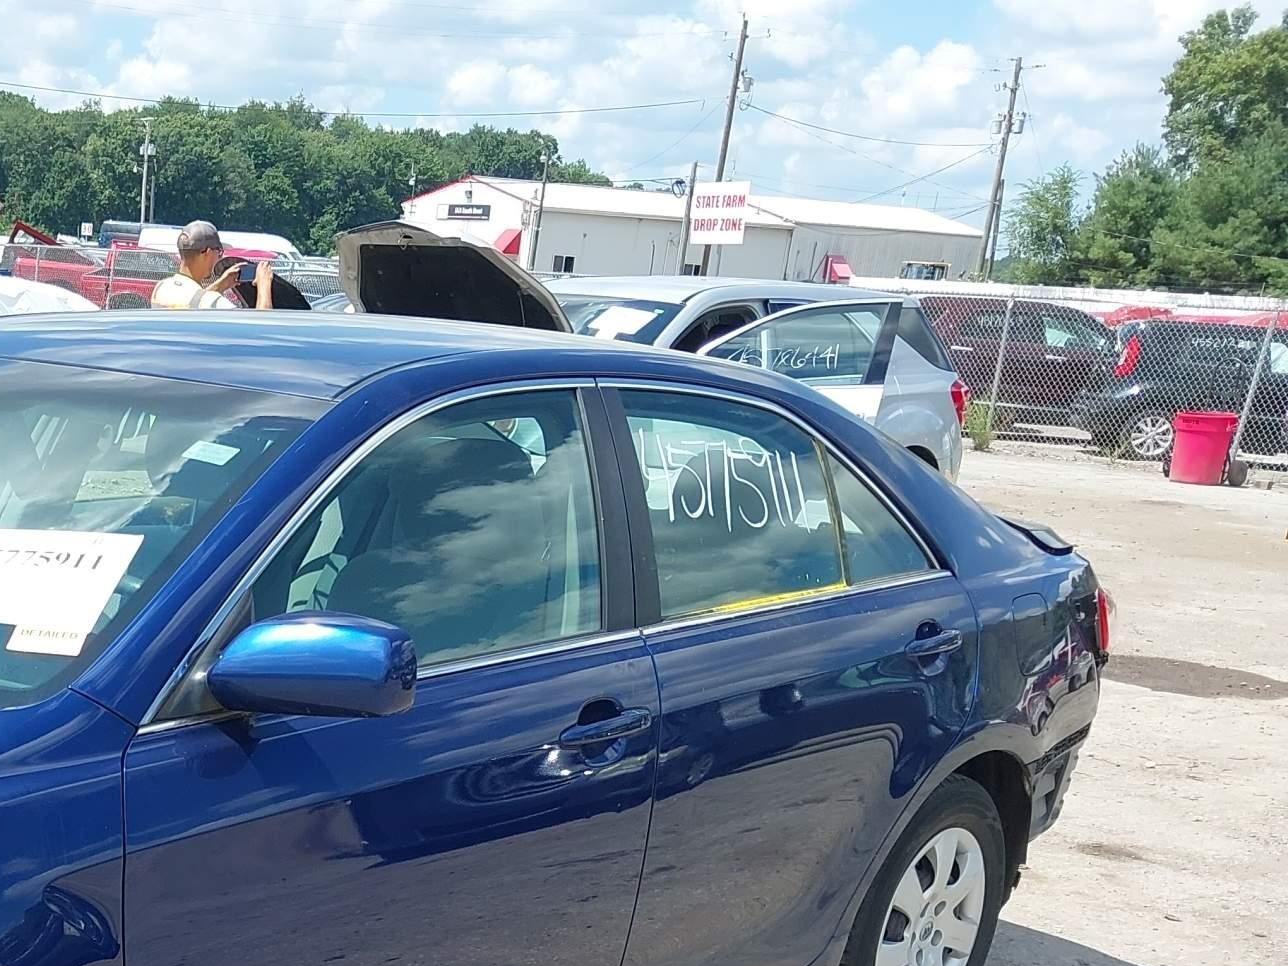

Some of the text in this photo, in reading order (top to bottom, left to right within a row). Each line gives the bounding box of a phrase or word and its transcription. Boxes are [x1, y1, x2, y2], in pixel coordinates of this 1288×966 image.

[695, 194, 746, 208] STATE FARM
[693, 218, 743, 232] DROP ZONE
[639, 427, 811, 534] 45775911
[20, 628, 79, 640] DETAILED
